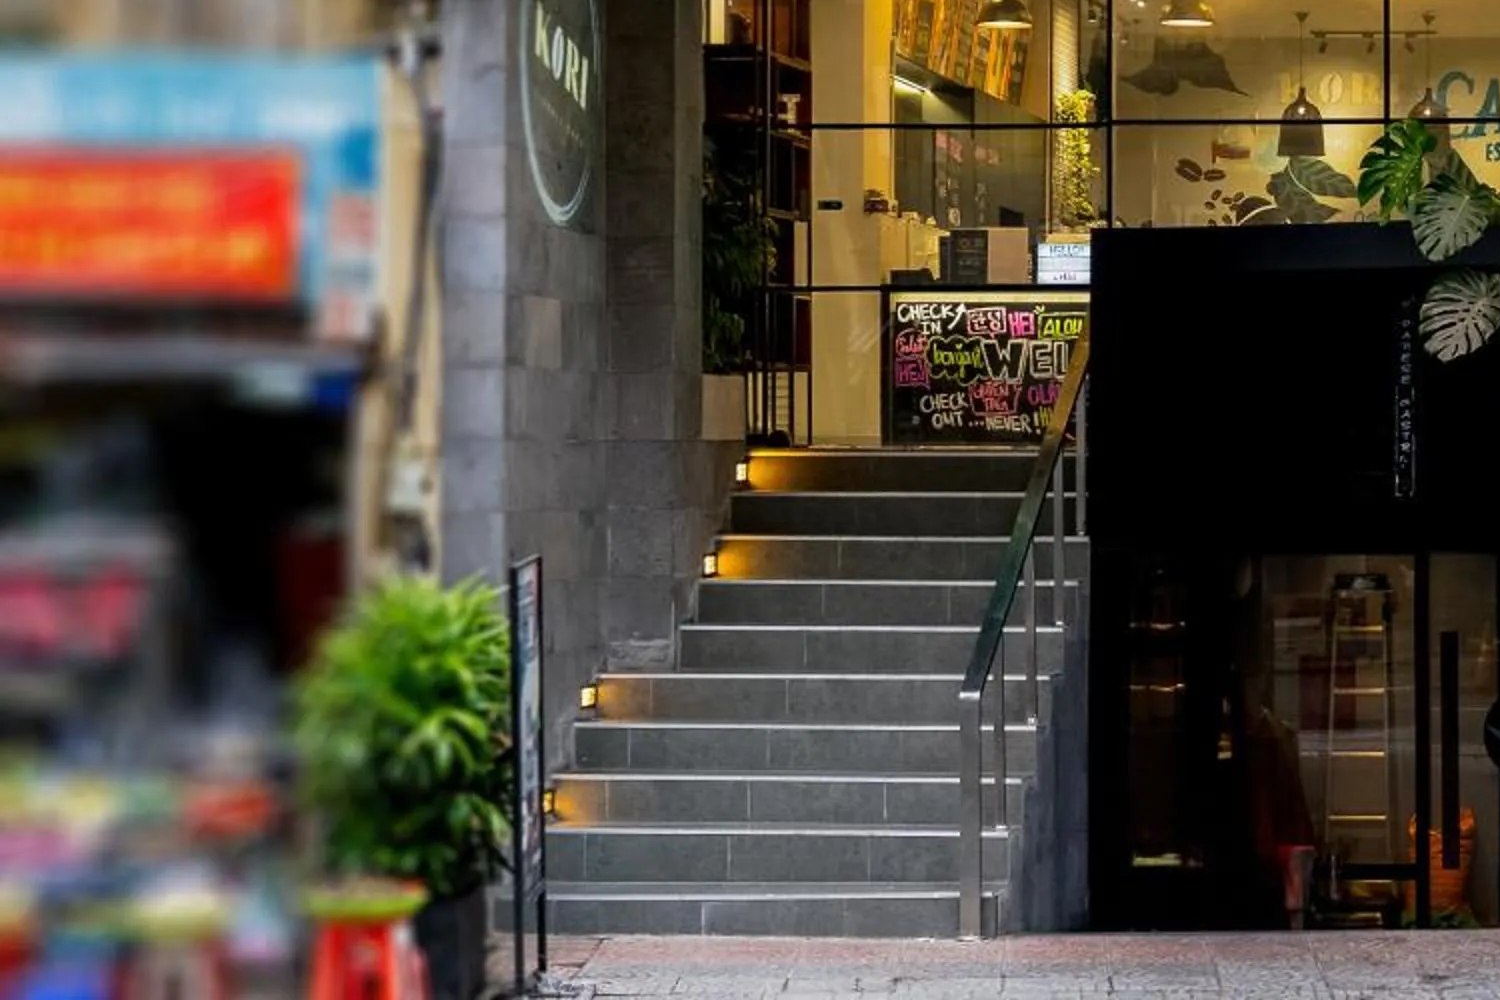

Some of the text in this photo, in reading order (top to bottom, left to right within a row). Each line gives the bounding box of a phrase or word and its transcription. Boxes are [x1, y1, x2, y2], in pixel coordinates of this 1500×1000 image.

[897, 303, 955, 323] CHECK
[921, 320, 943, 335] IN
[1043, 317, 1083, 338] ALOH
[981, 338, 1069, 384] WEL
[919, 391, 968, 413] CHECK
[931, 411, 963, 429] OUT
